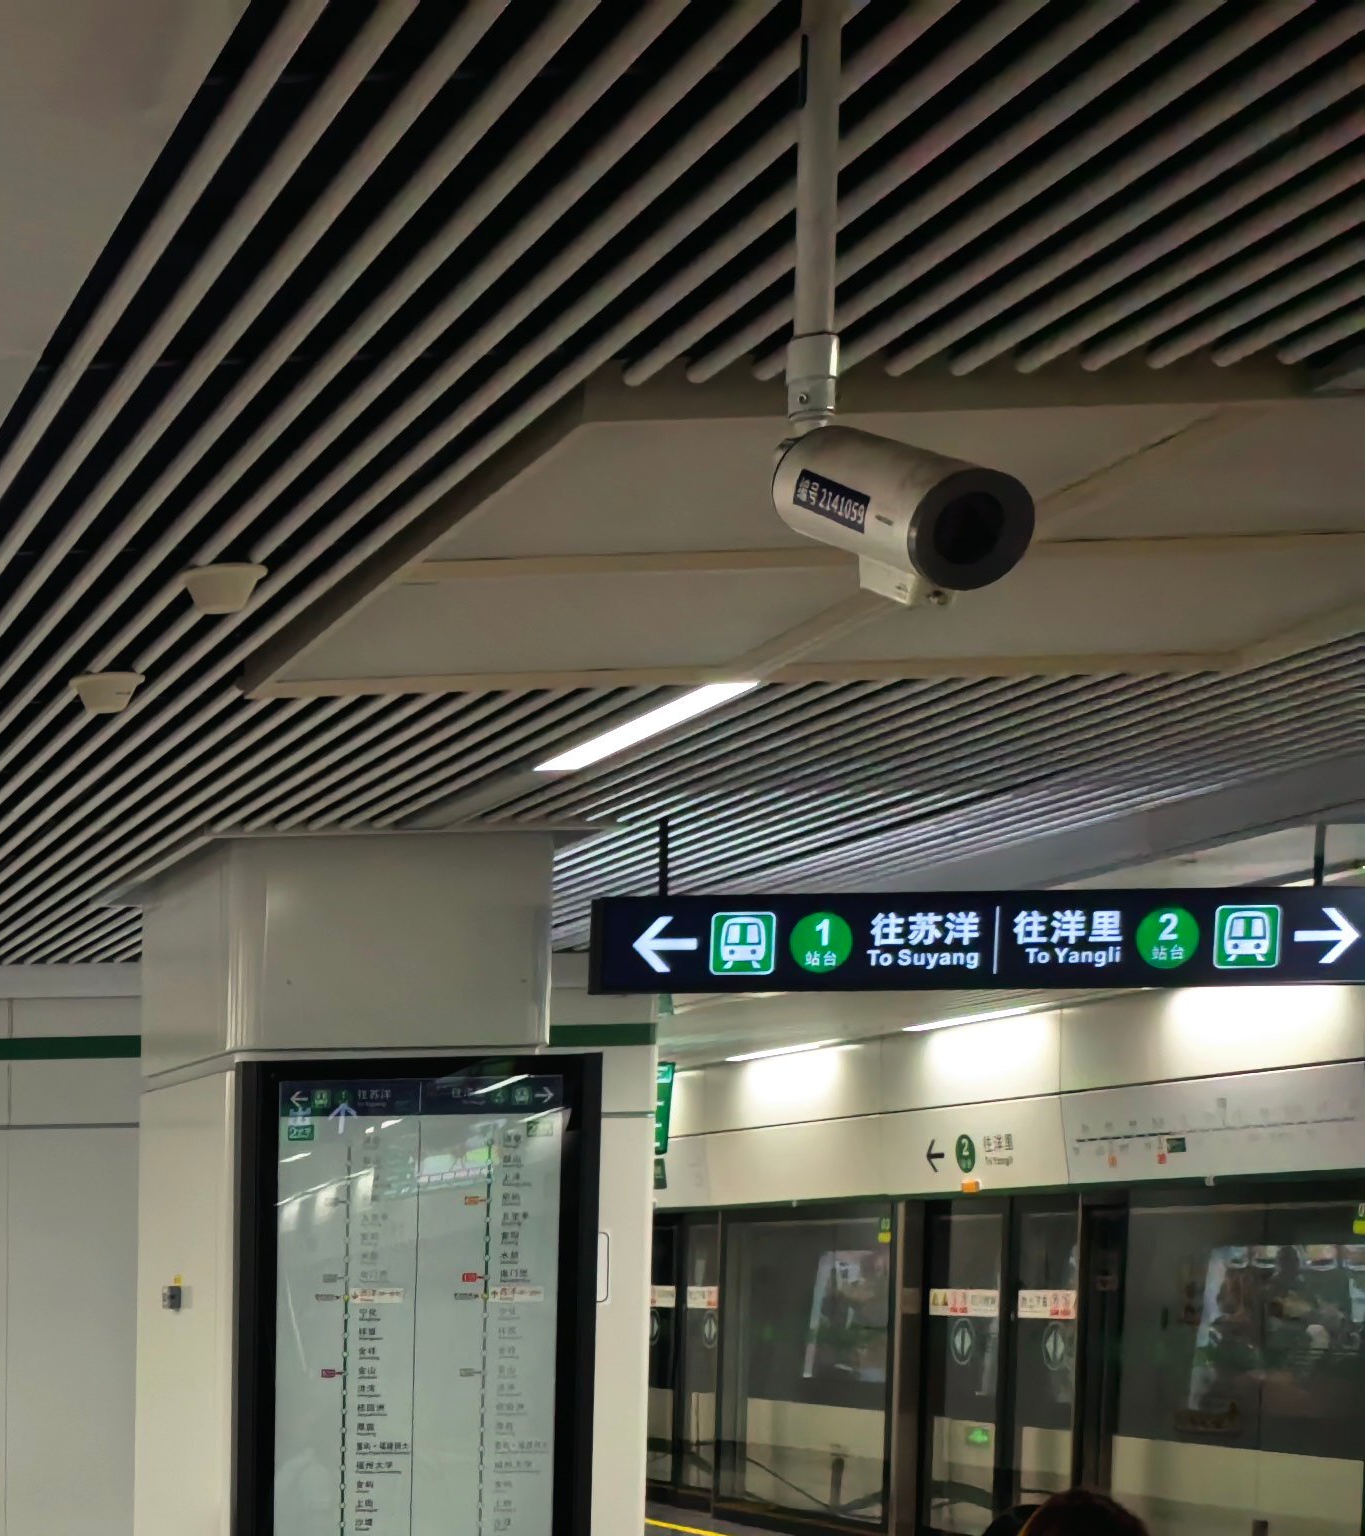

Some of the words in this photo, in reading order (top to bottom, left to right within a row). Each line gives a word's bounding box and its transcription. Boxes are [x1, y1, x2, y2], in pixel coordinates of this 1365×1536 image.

[816, 920, 829, 946] 1
[871, 911, 980, 946] 往苏洋
[1013, 910, 1123, 944] 往洋里
[1159, 913, 1178, 940] 2
[805, 950, 837, 966] 站台
[868, 950, 895, 966] To
[898, 949, 979, 969] Suyang
[1025, 948, 1049, 965] To
[1052, 947, 1121, 967] Yangli
[1151, 945, 1184, 962] 站台
[963, 1138, 970, 1156] 2
